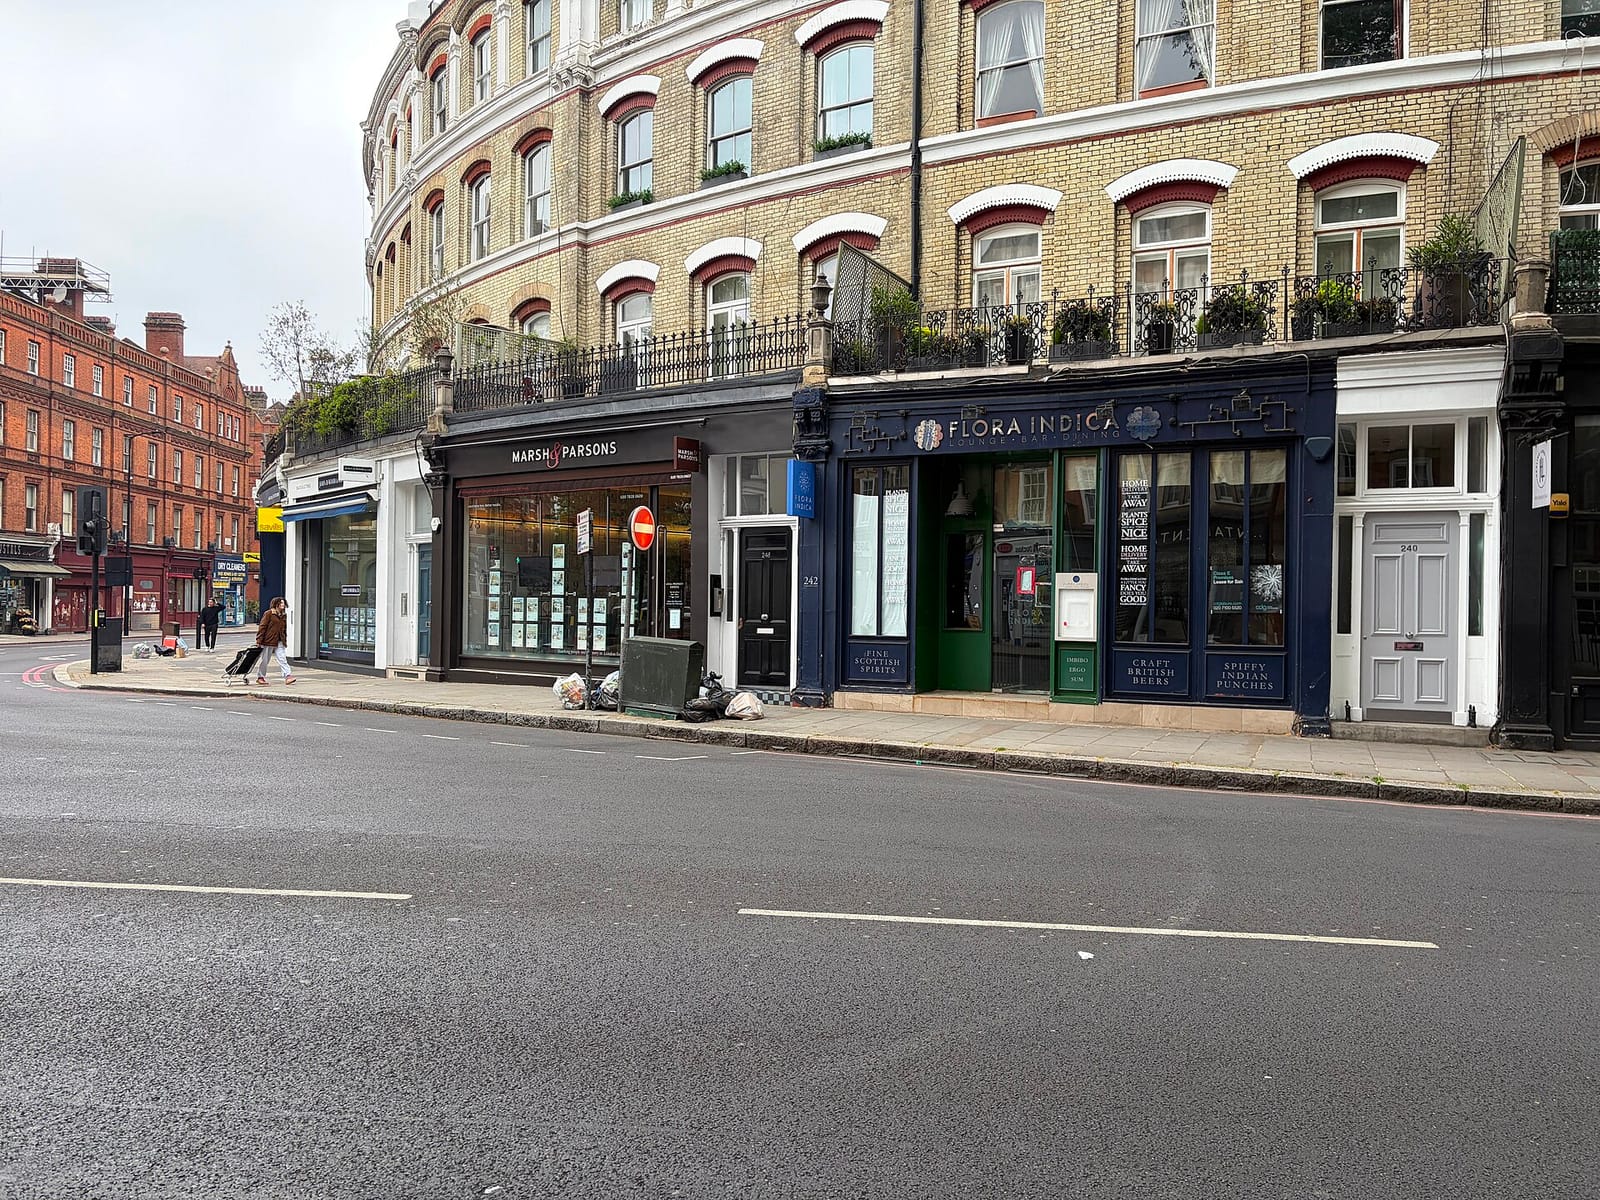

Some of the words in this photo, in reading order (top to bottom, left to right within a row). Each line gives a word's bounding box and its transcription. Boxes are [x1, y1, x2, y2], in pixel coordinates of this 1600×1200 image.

[949, 417, 1022, 438] FLORA
[1031, 413, 1120, 434] INDICA
[949, 437, 1006, 447] LOUNGE
[1021, 435, 1048, 443] BAR
[1062, 430, 1120, 441] DINING
[512, 448, 550, 463] MARSH
[562, 441, 617, 458] PARSONS
[677, 454, 698, 462] PARSONS
[1122, 479, 1149, 488] HOME
[794, 494, 812, 503] FLORA
[794, 503, 812, 511] INDICA
[1121, 499, 1148, 508] AWAY
[1121, 517, 1148, 526] SPICE
[259, 523, 283, 531] savills
[1121, 529, 1148, 538] NICE
[1121, 545, 1148, 553] HOME
[1400, 544, 1418, 553] 240
[217, 562, 226, 570] DRY
[226, 563, 246, 571] CLEANERS
[1120, 564, 1147, 573] AWAY
[803, 576, 818, 585] 242
[1120, 595, 1147, 603] GOOD
[1010, 609, 1044, 617] FLORA
[1009, 617, 1044, 625] INDICA
[866, 650, 889, 658] FINE
[854, 657, 900, 666] SCOTTISH
[1132, 659, 1170, 668] CRAFT
[860, 665, 896, 673] SPIRITS
[1224, 662, 1266, 671] SPIFFY
[1127, 667, 1175, 677] BRITISH
[1222, 671, 1268, 680] INDIAN
[1132, 676, 1169, 686] BEERS
[1216, 680, 1274, 690] PUNCHES
